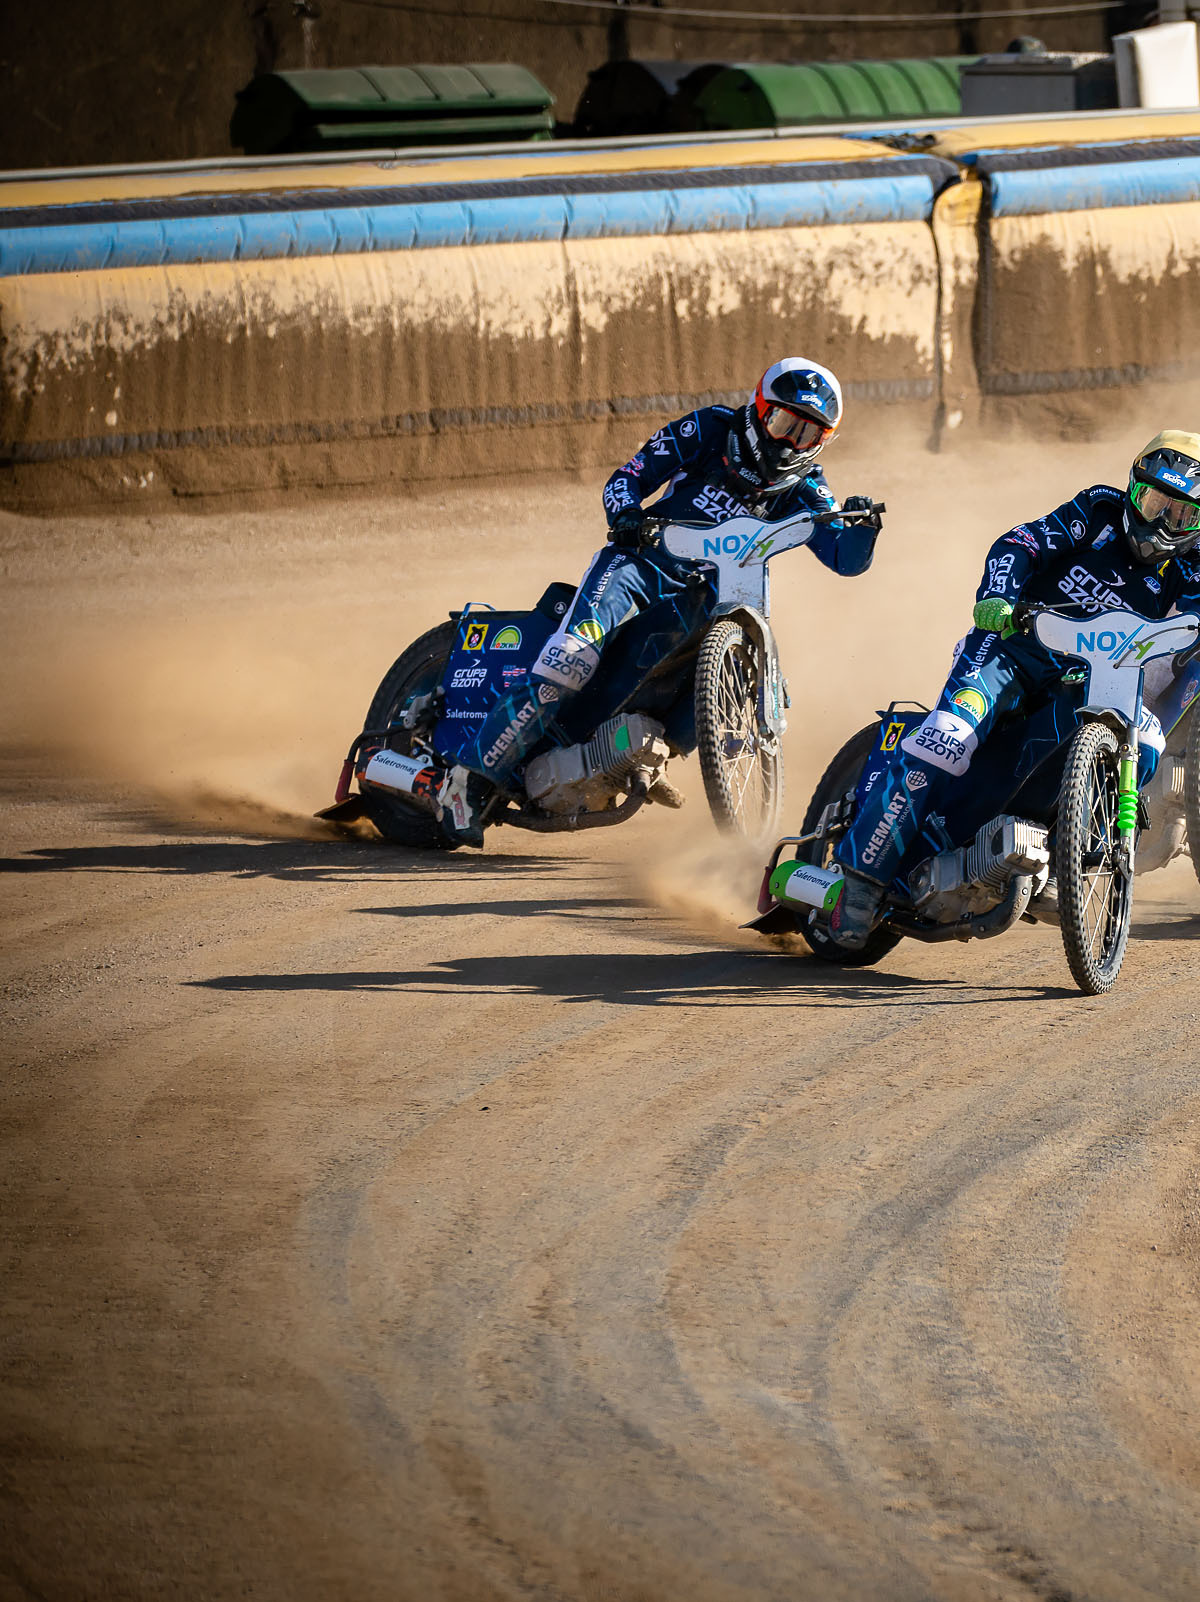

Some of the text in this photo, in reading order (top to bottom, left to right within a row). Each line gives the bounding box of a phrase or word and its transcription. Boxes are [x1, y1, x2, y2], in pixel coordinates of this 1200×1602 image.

[1089, 488, 1121, 499] CHEMART
[588, 553, 627, 609] Saletromag
[966, 633, 998, 680] Saletrom
[446, 708, 488, 719] Saletroma
[483, 701, 536, 768] CHEMART
[373, 755, 418, 775] Saletromag
[862, 792, 907, 865] CHEMART
[874, 825, 902, 869] INTERNATIONAL
[793, 869, 831, 889] Saletromag
